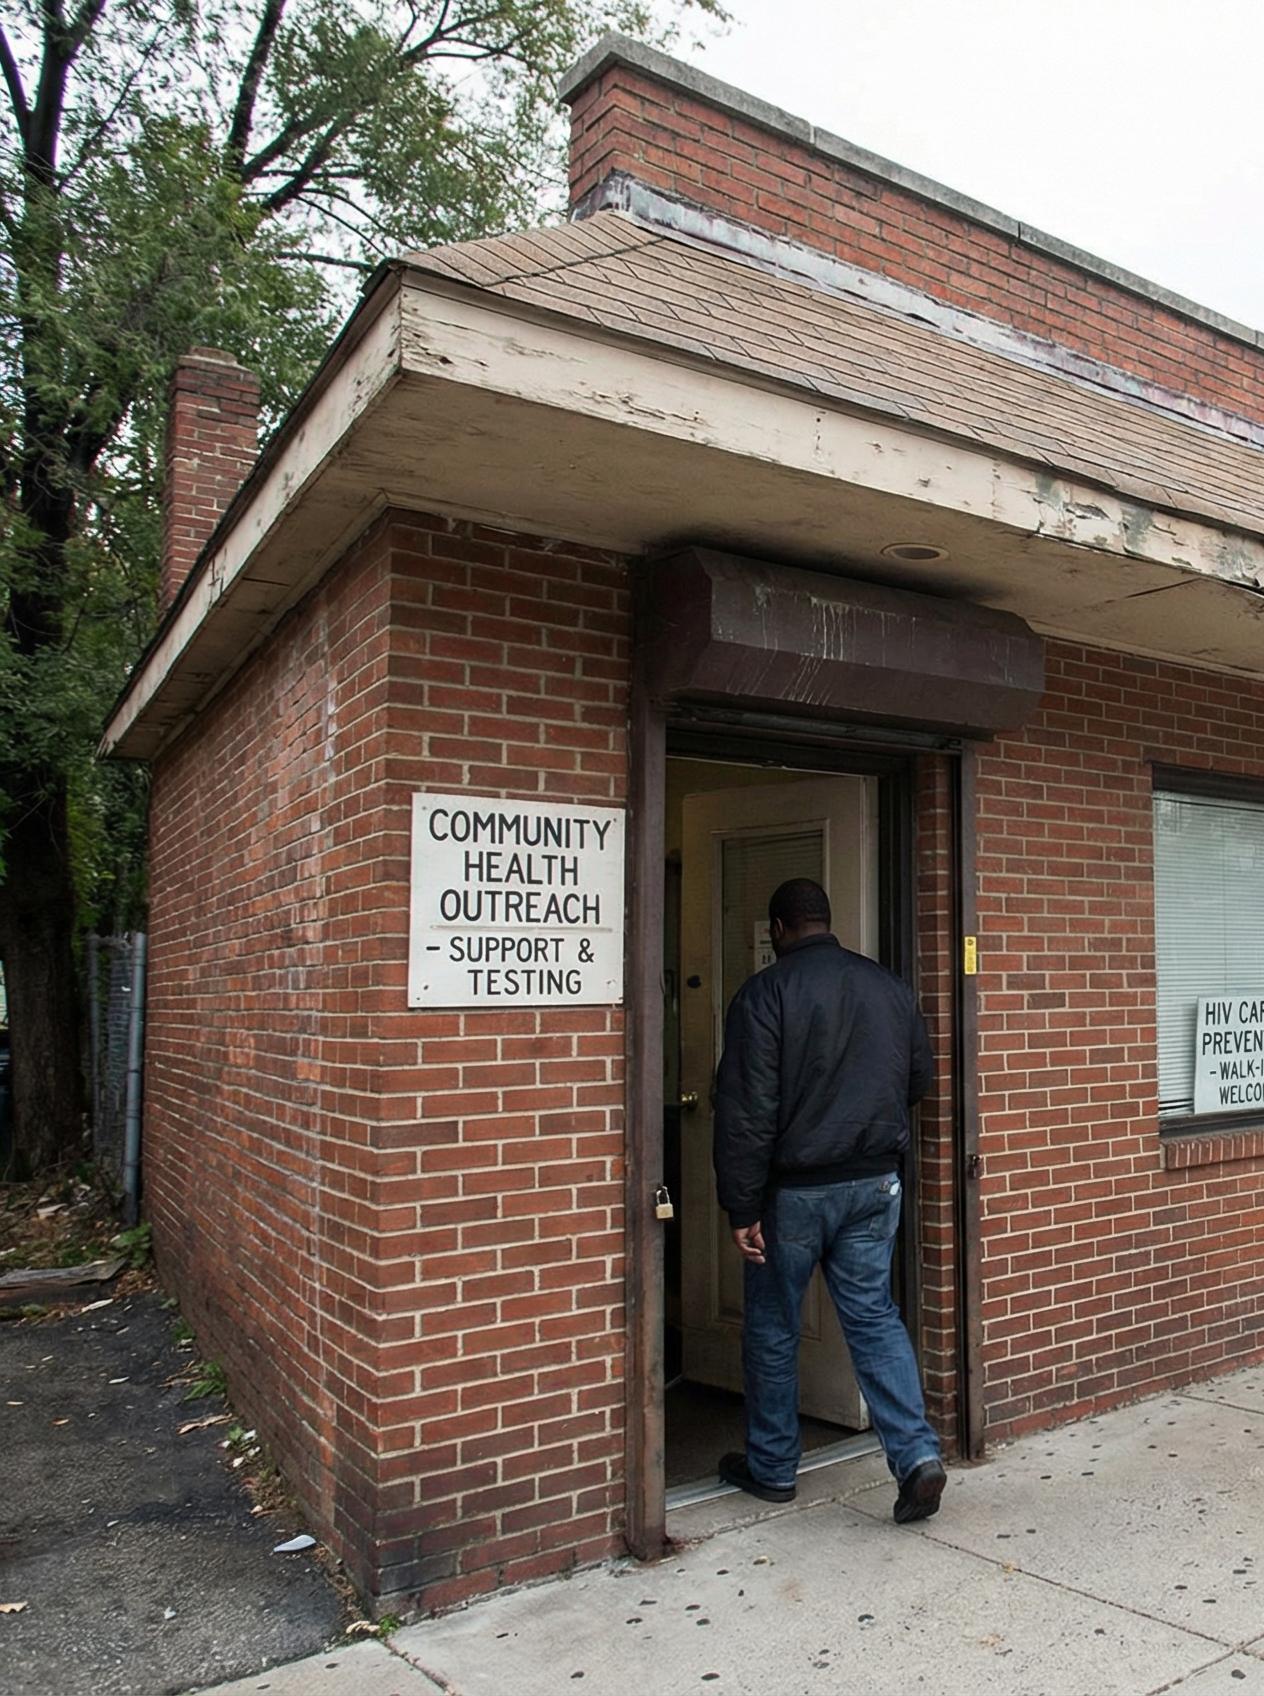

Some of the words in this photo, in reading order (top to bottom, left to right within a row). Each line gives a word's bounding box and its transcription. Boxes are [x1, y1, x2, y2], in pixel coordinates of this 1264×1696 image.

[429, 808, 611, 850] COMMUNITY
[464, 850, 578, 886] HEALTH
[440, 889, 600, 924] OUTREACH
[449, 936, 564, 962] SUPPORT
[577, 938, 595, 963] &
[467, 969, 582, 995] TESTING
[1205, 1002, 1232, 1025] HIV
